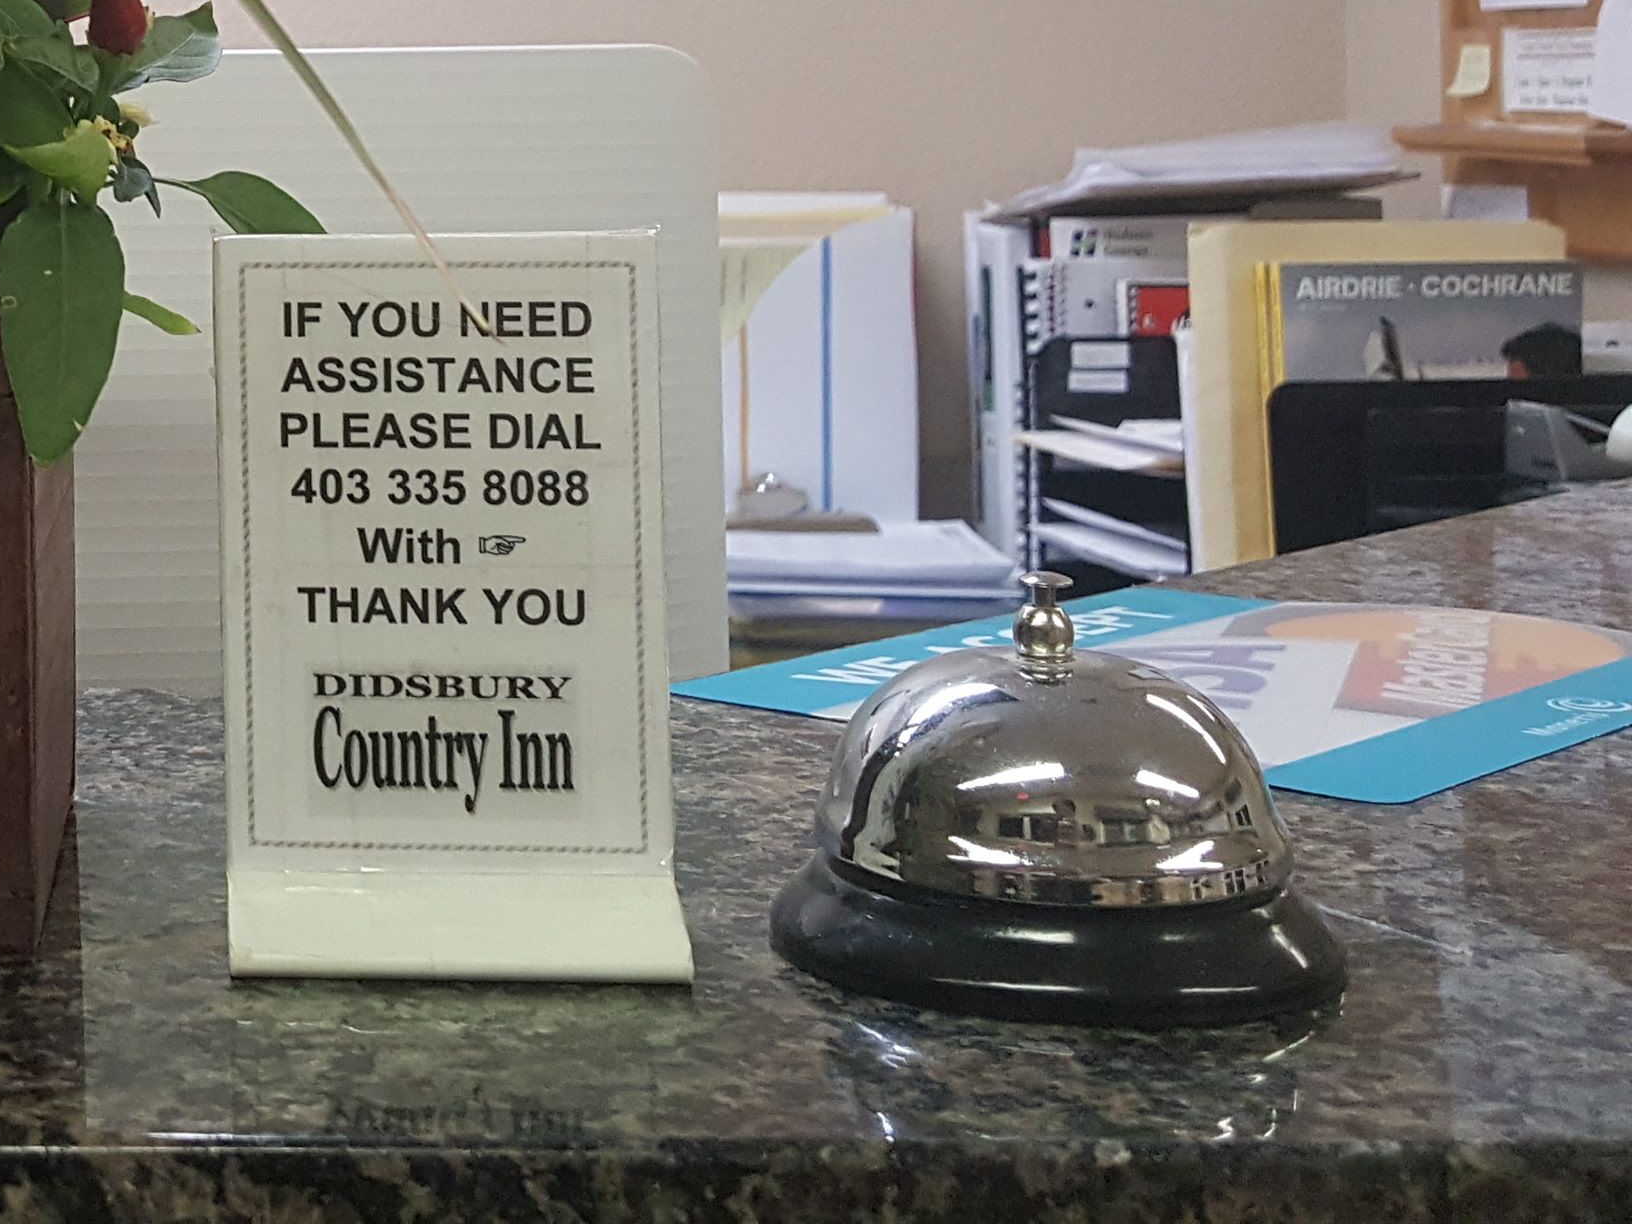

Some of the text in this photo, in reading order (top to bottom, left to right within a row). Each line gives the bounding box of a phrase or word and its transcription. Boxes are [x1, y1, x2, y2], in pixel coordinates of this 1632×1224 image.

[1296, 273, 1574, 299] AIRDRIE COCHRANE
[282, 301, 593, 338] IF YOU NEED
[280, 356, 596, 394] ASSISTANCE
[279, 412, 603, 450] PLEASE DIAL
[290, 468, 590, 507] 403 335 8088
[356, 527, 461, 565] With
[297, 586, 587, 627] THANK YOU
[313, 672, 573, 700] DIDSBURY
[791, 655, 920, 685] WE
[313, 705, 575, 814] Country Inn
